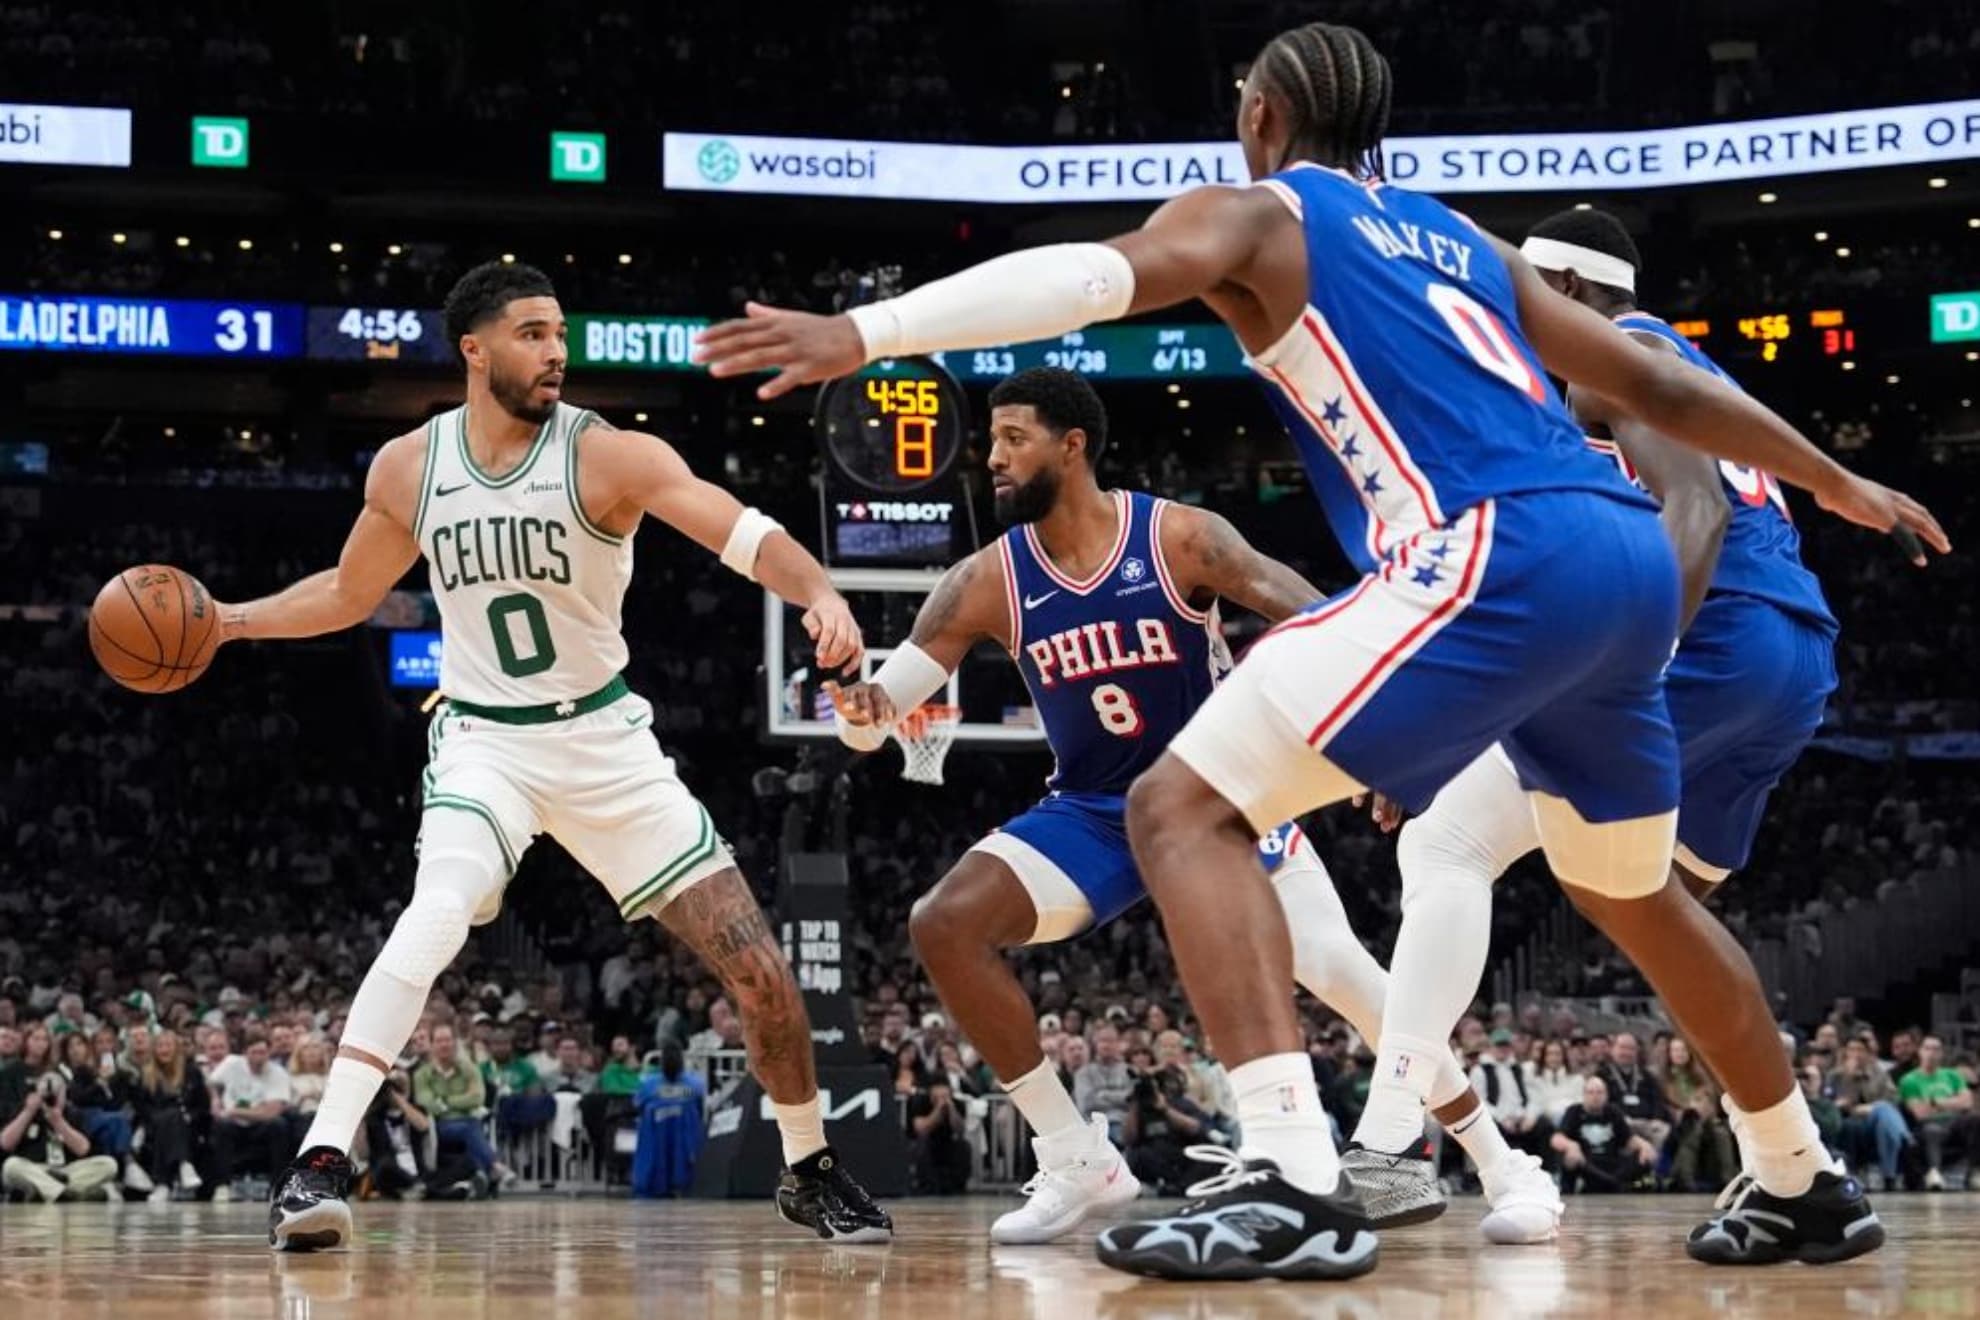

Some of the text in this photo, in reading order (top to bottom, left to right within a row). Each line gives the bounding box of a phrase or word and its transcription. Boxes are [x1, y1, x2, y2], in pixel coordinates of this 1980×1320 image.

[0, 113, 41, 144] bi
[197, 125, 244, 157] TD
[556, 140, 600, 171] TD
[750, 149, 876, 179] wasabi
[1019, 157, 1238, 188] OFFICIAL
[1441, 145, 1662, 179] STORAGE
[1684, 122, 1901, 170] PARTNER
[1925, 114, 1980, 146] OF
[214, 308, 272, 351] 31
[338, 308, 423, 341] 4:56
[1936, 301, 1979, 332] TD
[1152, 349, 1207, 371] 6/13
[1426, 282, 1546, 405] 0
[867, 380, 940, 415] 4:56
[897, 416, 934, 477] 8
[867, 502, 953, 522] TISSOT
[432, 516, 571, 592] CELTICS
[487, 592, 556, 678] 0
[1026, 618, 1182, 687] PHILA
[1091, 683, 1145, 736] 8
